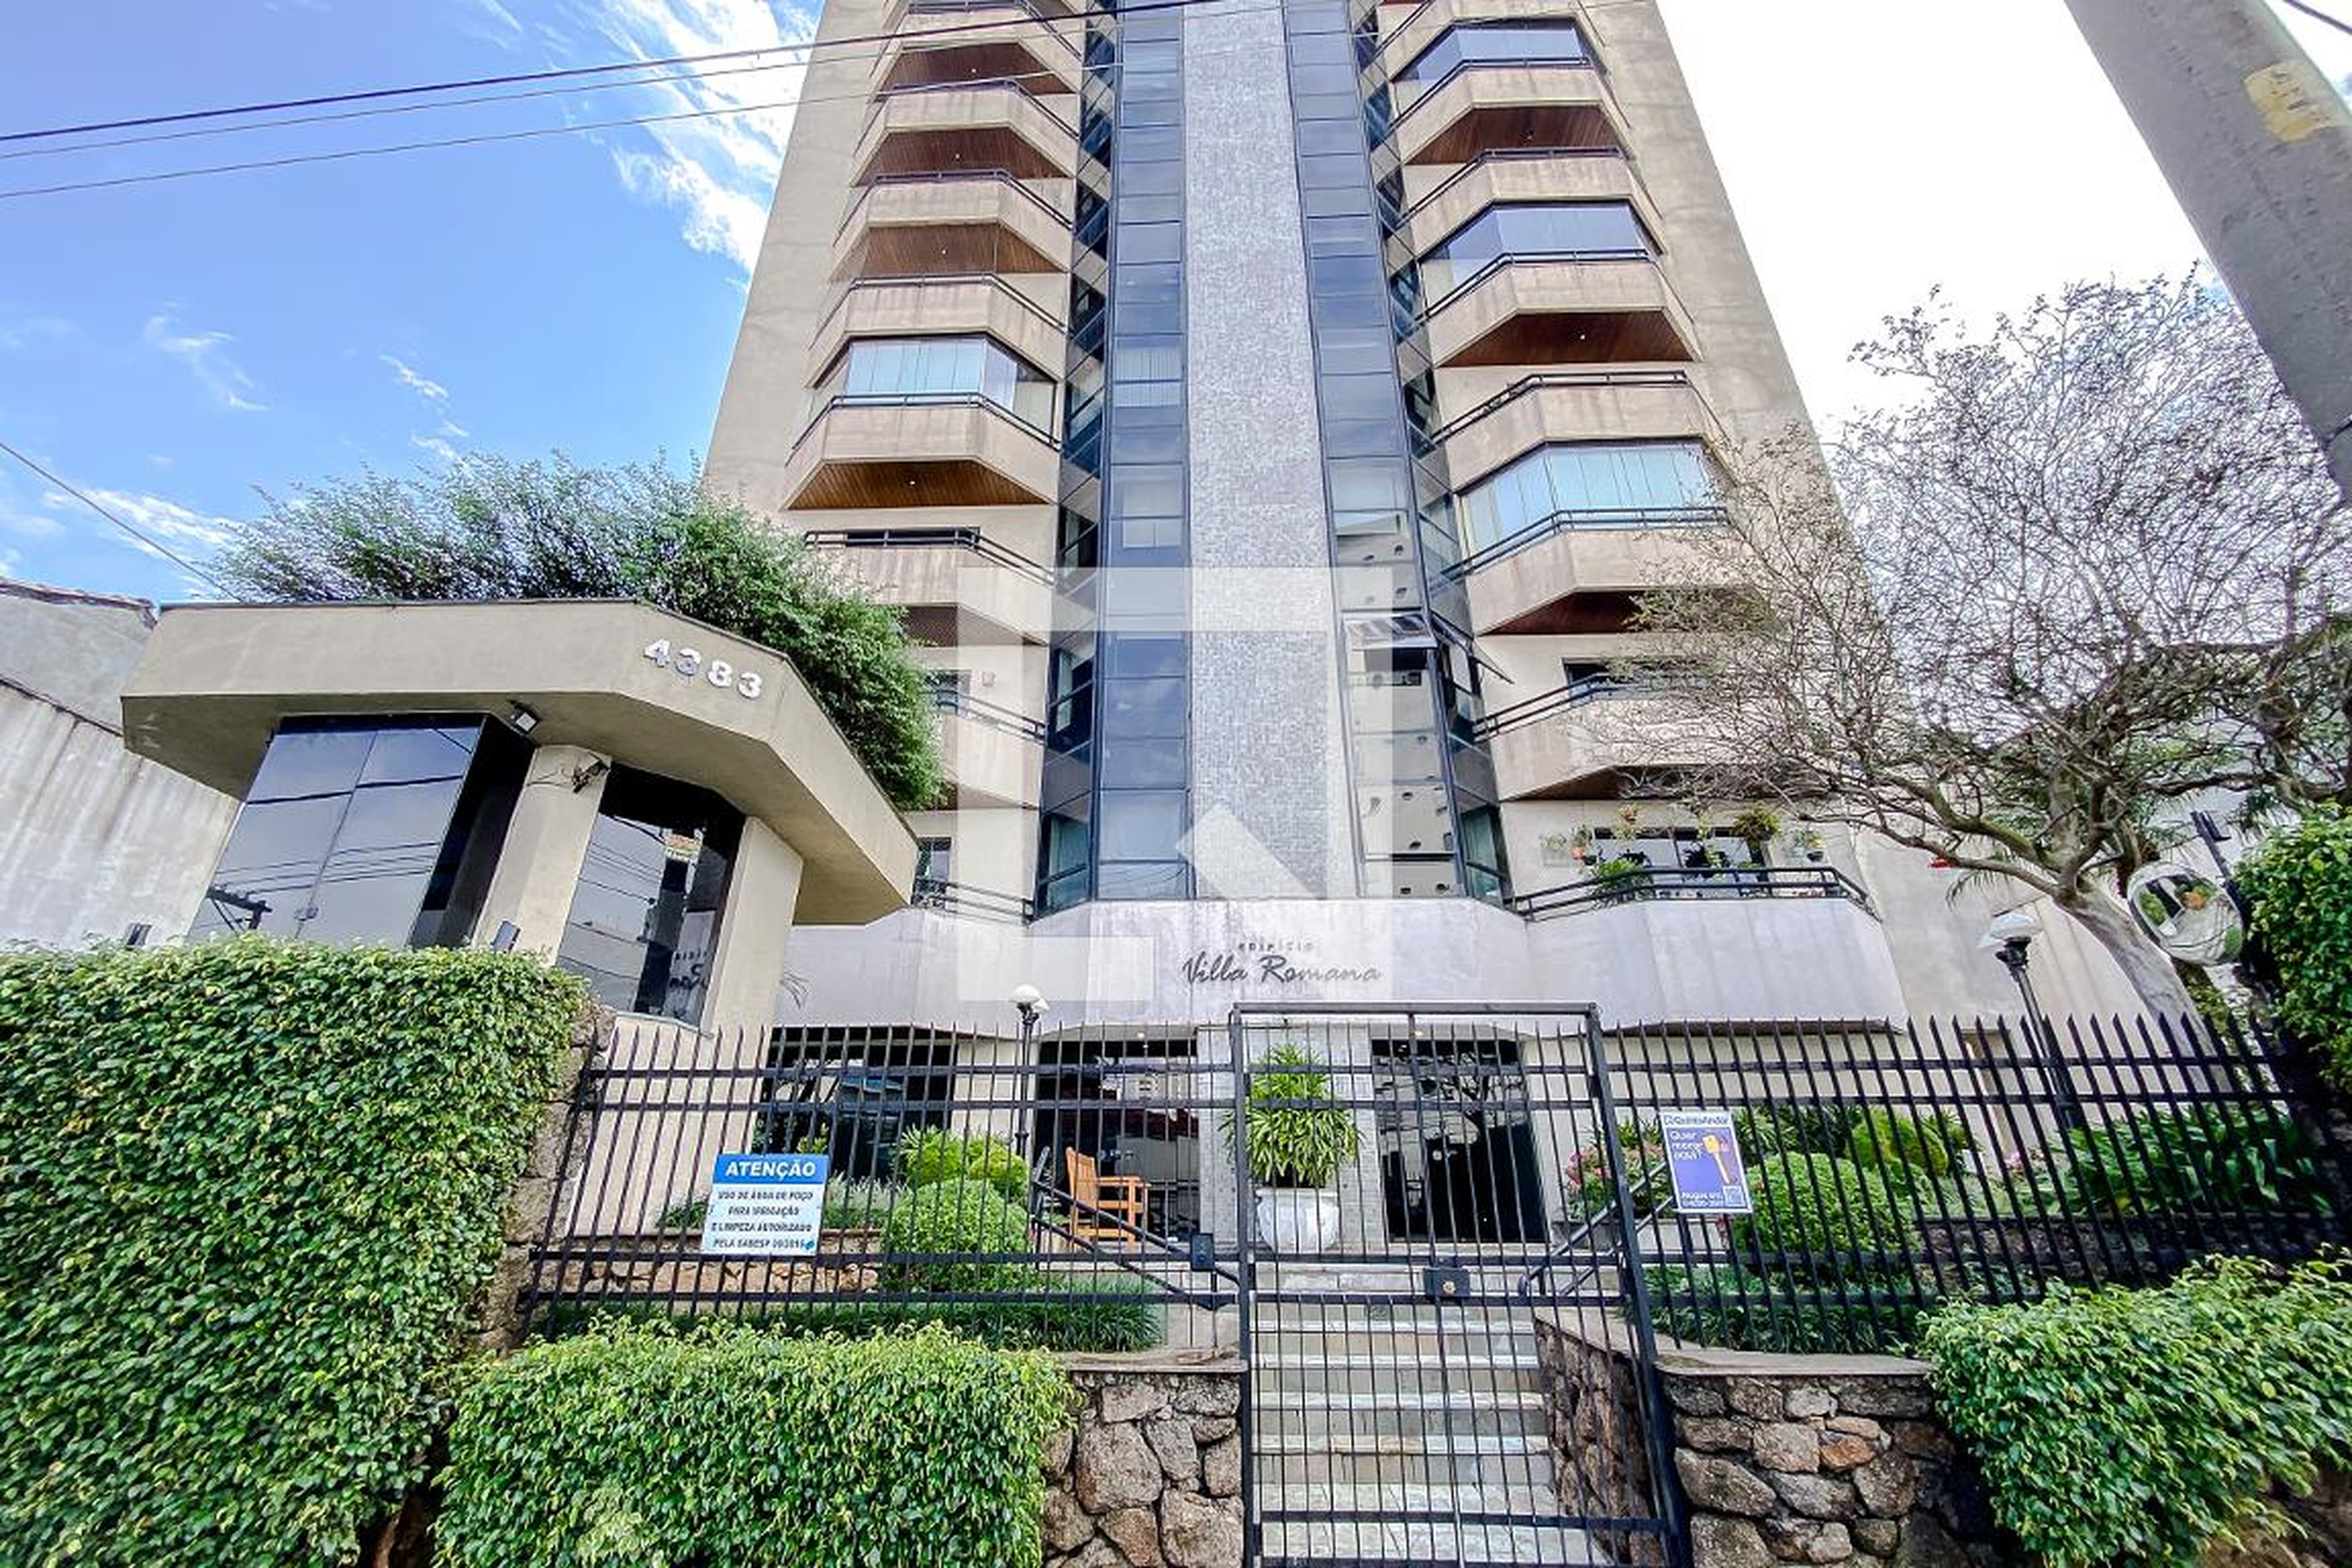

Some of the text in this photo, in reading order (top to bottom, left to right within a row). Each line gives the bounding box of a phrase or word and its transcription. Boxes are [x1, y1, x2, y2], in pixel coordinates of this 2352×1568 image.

[643, 638, 762, 699] 4383
[1182, 951, 1380, 983] Villa Romana
[725, 1159, 816, 1181] ATENÇÃO
[728, 1206, 750, 1215] PARA
[718, 1223, 755, 1231] LIMPEZA
[714, 1238, 734, 1248] PELA
[737, 1238, 771, 1248] SABESP
